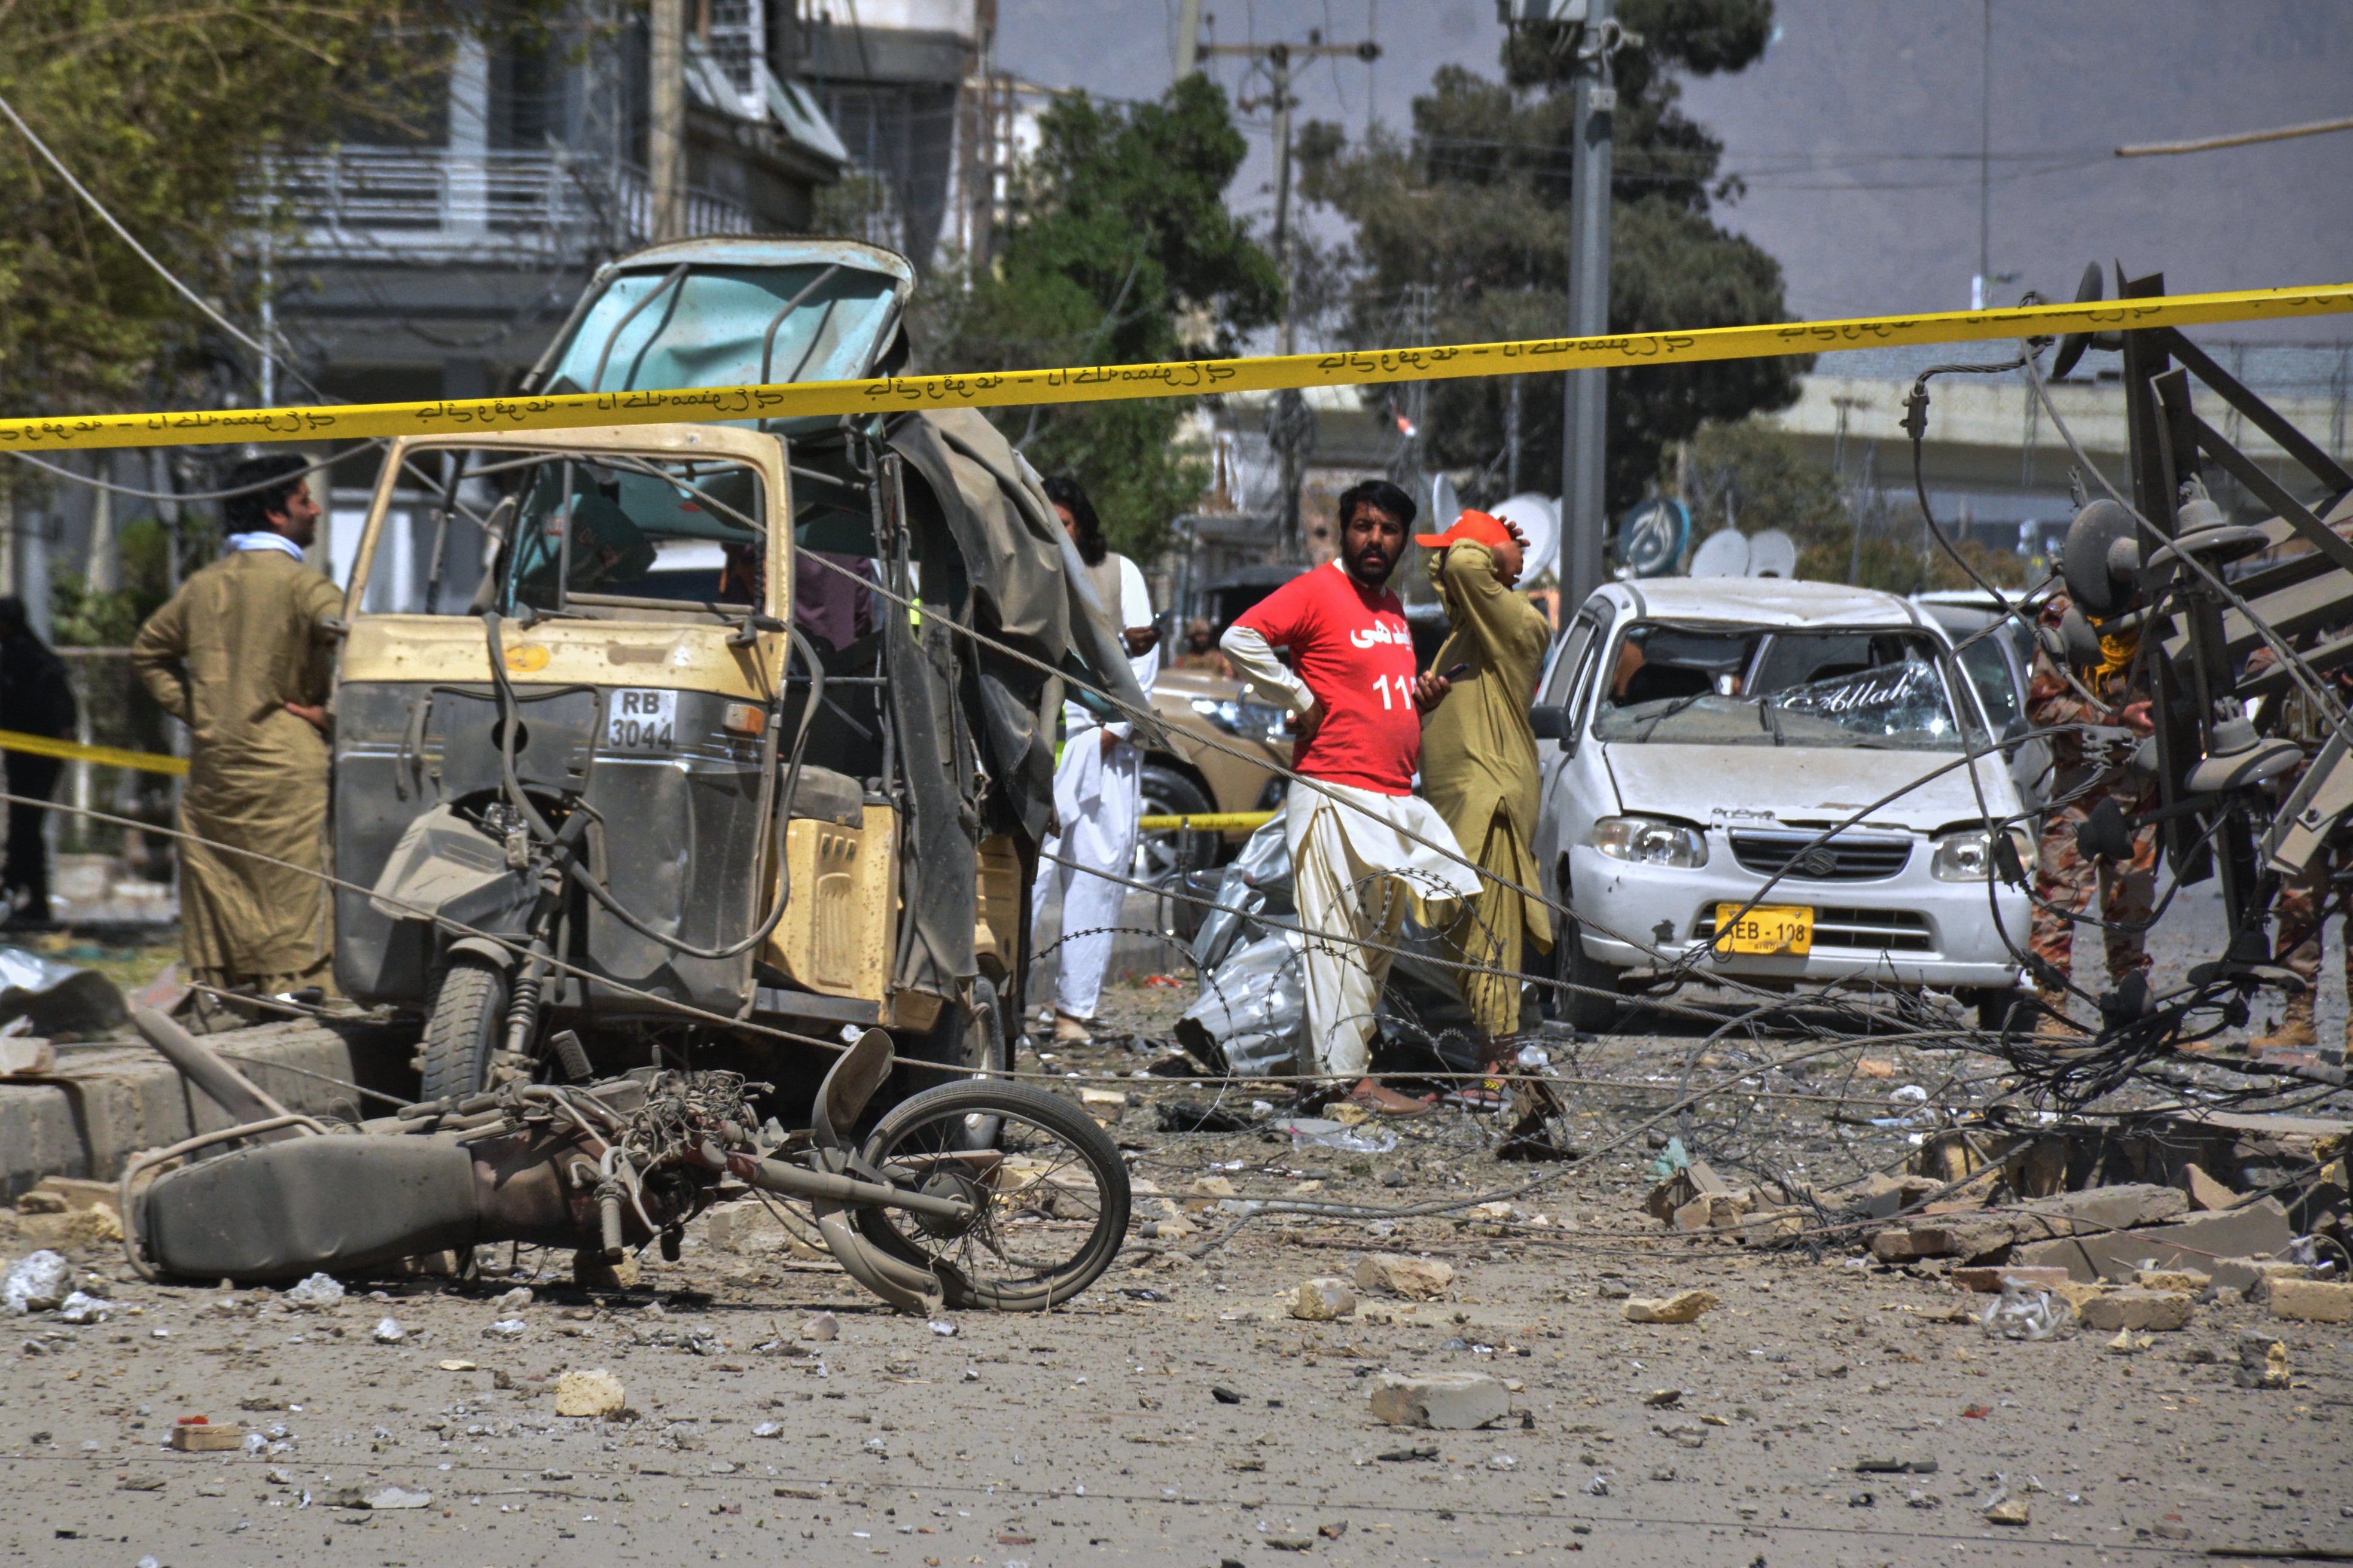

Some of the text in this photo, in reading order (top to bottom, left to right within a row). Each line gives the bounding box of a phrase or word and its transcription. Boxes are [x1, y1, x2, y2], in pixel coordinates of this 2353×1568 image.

[622, 691, 660, 715] RB
[1372, 674, 1417, 710] 11
[610, 719, 672, 750] 3044
[1776, 923, 1805, 942] 108
[1753, 941, 1779, 950] SIND
